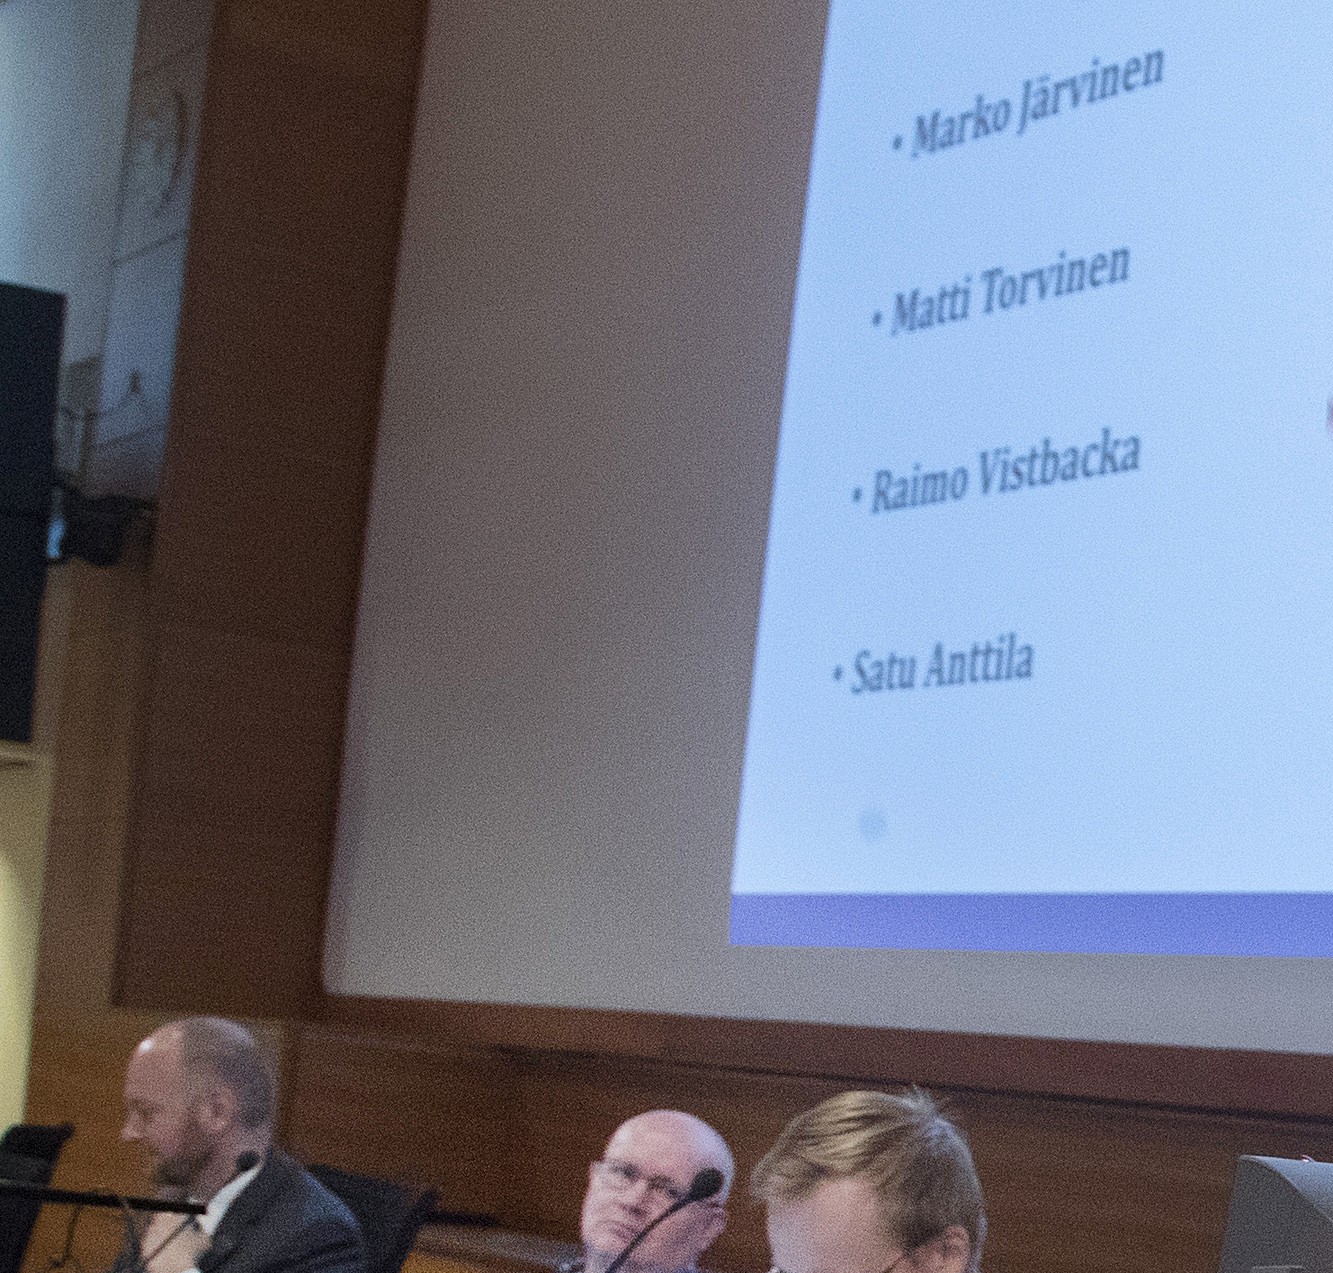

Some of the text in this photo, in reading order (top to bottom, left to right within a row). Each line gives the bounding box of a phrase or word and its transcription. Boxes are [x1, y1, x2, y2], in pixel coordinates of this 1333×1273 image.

[911, 49, 1165, 159] Marko Järvinen
[891, 246, 1131, 336] Matti Torvinen
[871, 427, 1140, 513] Raimo Vistbacka
[850, 632, 1034, 695] Satu Anttila
